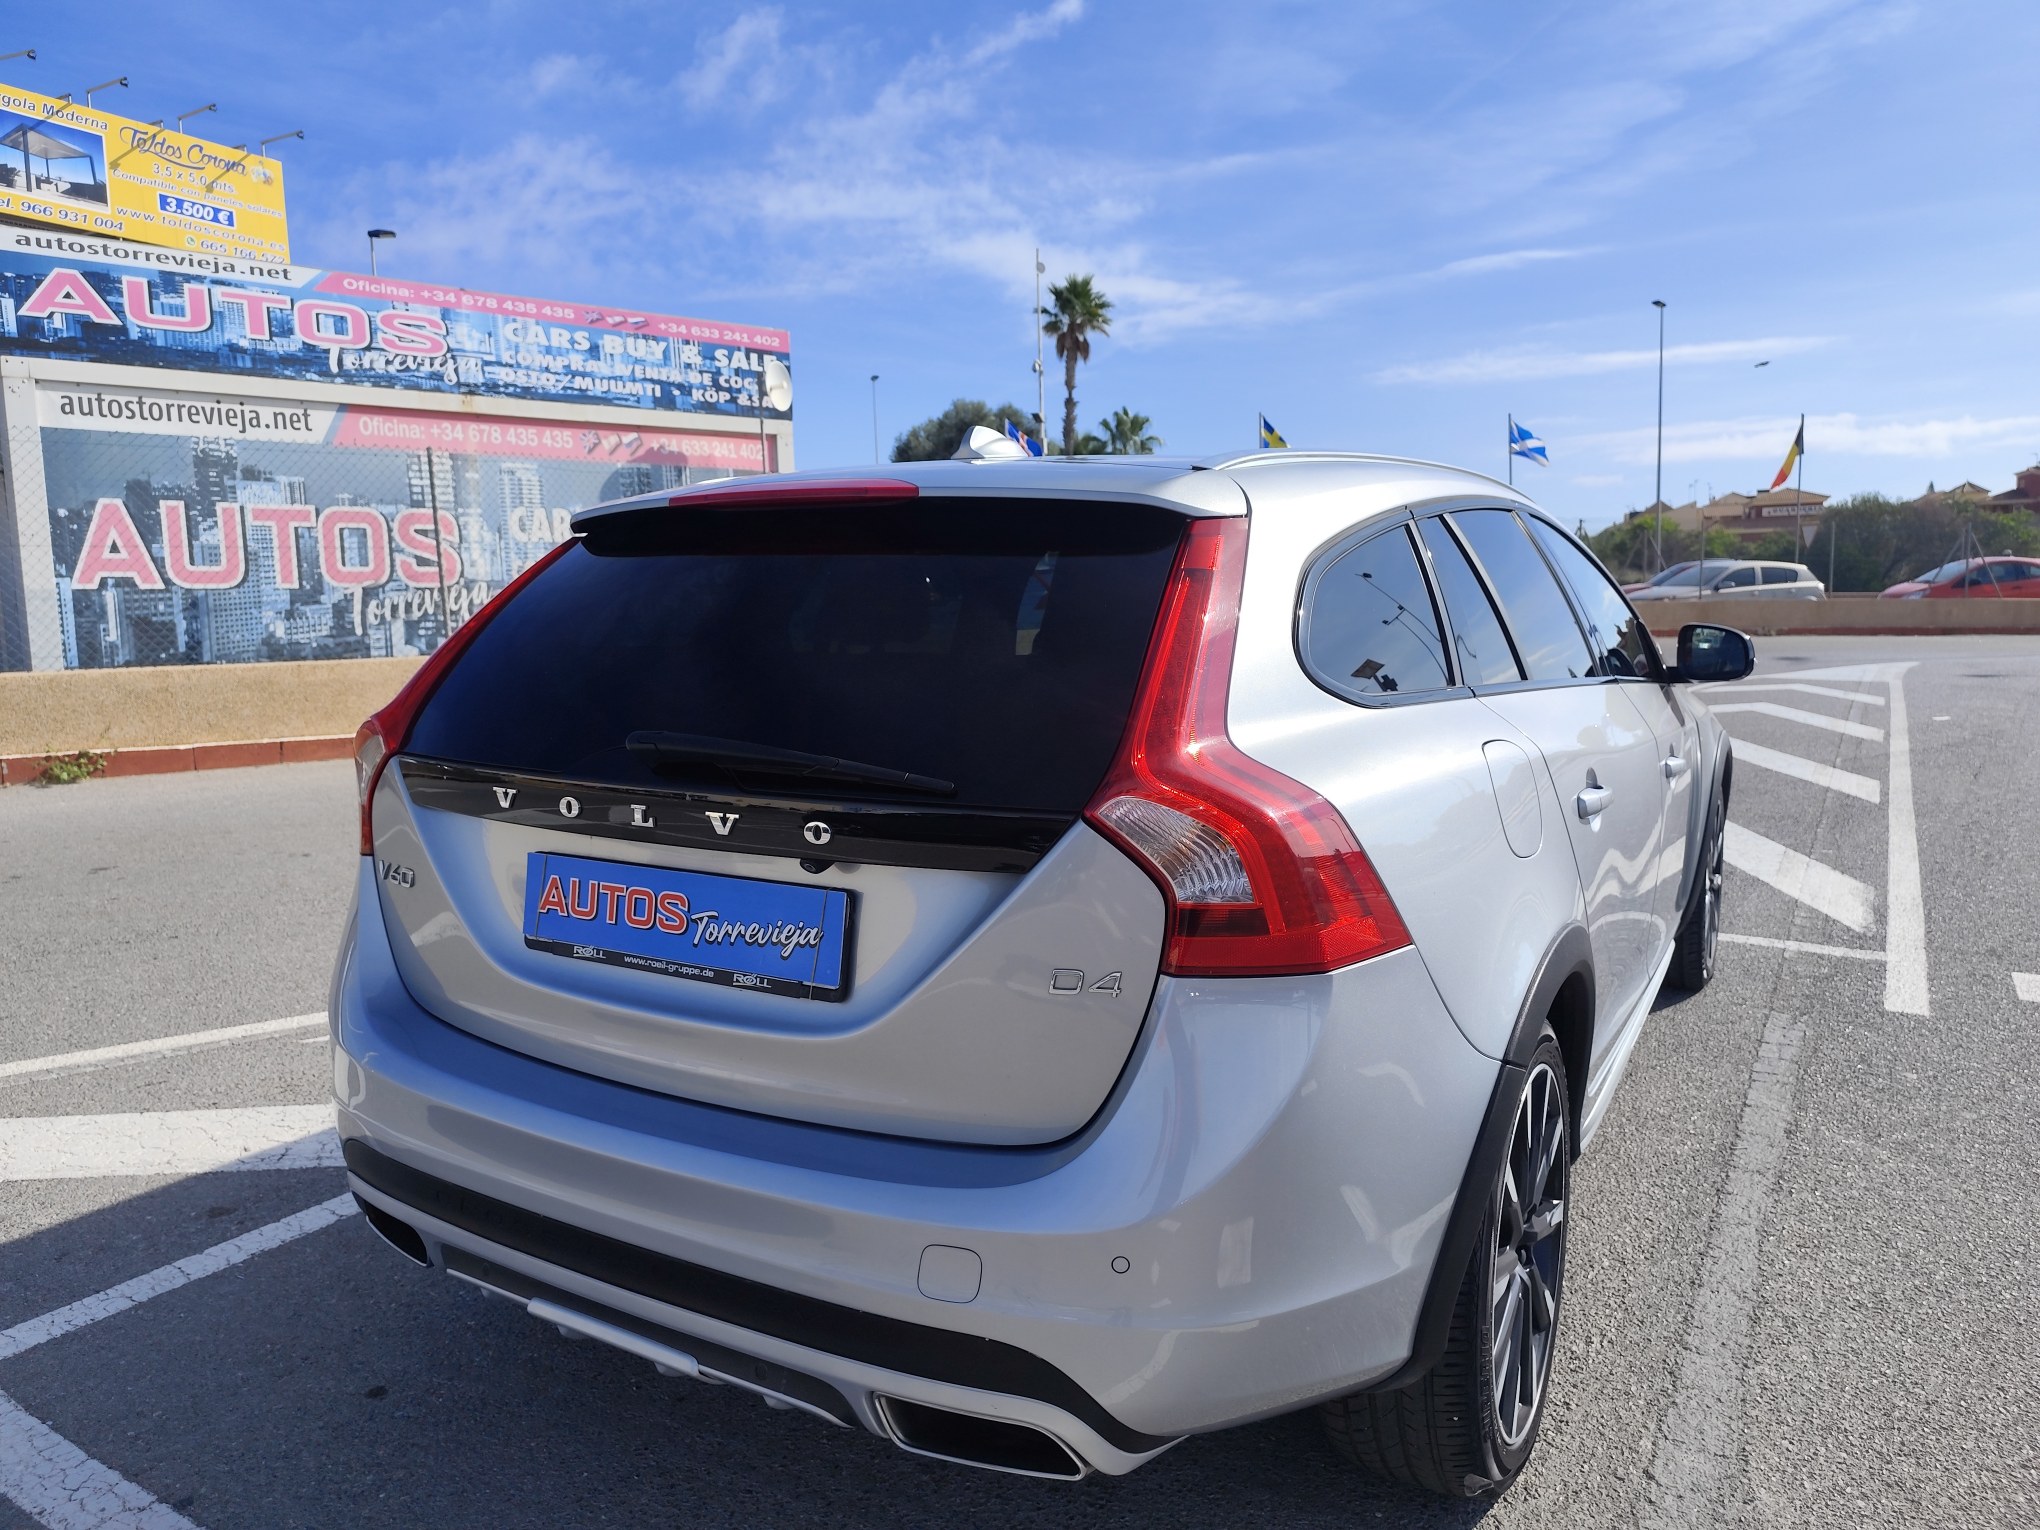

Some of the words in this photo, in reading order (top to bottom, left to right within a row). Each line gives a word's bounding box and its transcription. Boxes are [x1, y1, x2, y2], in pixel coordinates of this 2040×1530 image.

[0, 94, 36, 111] gola
[42, 103, 108, 130] Moderna
[119, 126, 190, 163] Toldos
[187, 143, 248, 176] Corona
[112, 168, 177, 191] Compatible
[181, 186, 200, 197] con
[203, 191, 243, 208] paneles
[247, 203, 282, 218] solares
[176, 172, 183, 180] x
[21, 201, 53, 216] 966
[58, 209, 88, 224] 931
[94, 217, 124, 231] 004
[116, 207, 285, 251] www.toldoscorona.es
[165, 197, 214, 221] 3.500
[217, 211, 230, 225] €
[15, 232, 292, 281] autostorrevieja.net
[200, 240, 227, 253] 665
[233, 246, 257, 260] 166
[17, 267, 449, 358] AUTOS
[342, 277, 415, 298] Oficina:
[420, 288, 457, 304] +34
[461, 294, 498, 309] 678
[502, 300, 537, 314] 435
[541, 304, 575, 320] 435
[503, 322, 591, 351] CARS
[602, 334, 667, 360] BUY
[681, 344, 703, 365] &
[658, 322, 687, 334] +34
[690, 326, 719, 338] 633
[723, 330, 750, 343] 241
[753, 334, 781, 347] 402
[320, 345, 484, 385] Torrevieja
[502, 351, 601, 372] COMPRA
[688, 371, 713, 386] DE
[60, 391, 313, 433] autostorrevieja.net
[691, 386, 731, 404] KÖP
[359, 416, 426, 439] Oficina:
[430, 422, 464, 441] +34
[468, 425, 501, 444] 678
[506, 427, 538, 447] 435
[542, 430, 574, 449] 435
[650, 438, 679, 455] +34
[681, 439, 710, 456] 633
[712, 441, 738, 459] 241
[740, 443, 764, 460] 402
[71, 497, 463, 590] AUTOS
[492, 786, 833, 845] VOLVO
[379, 859, 416, 888] V60
[539, 874, 690, 935] AUTOS
[691, 911, 823, 957] Torrevieja
